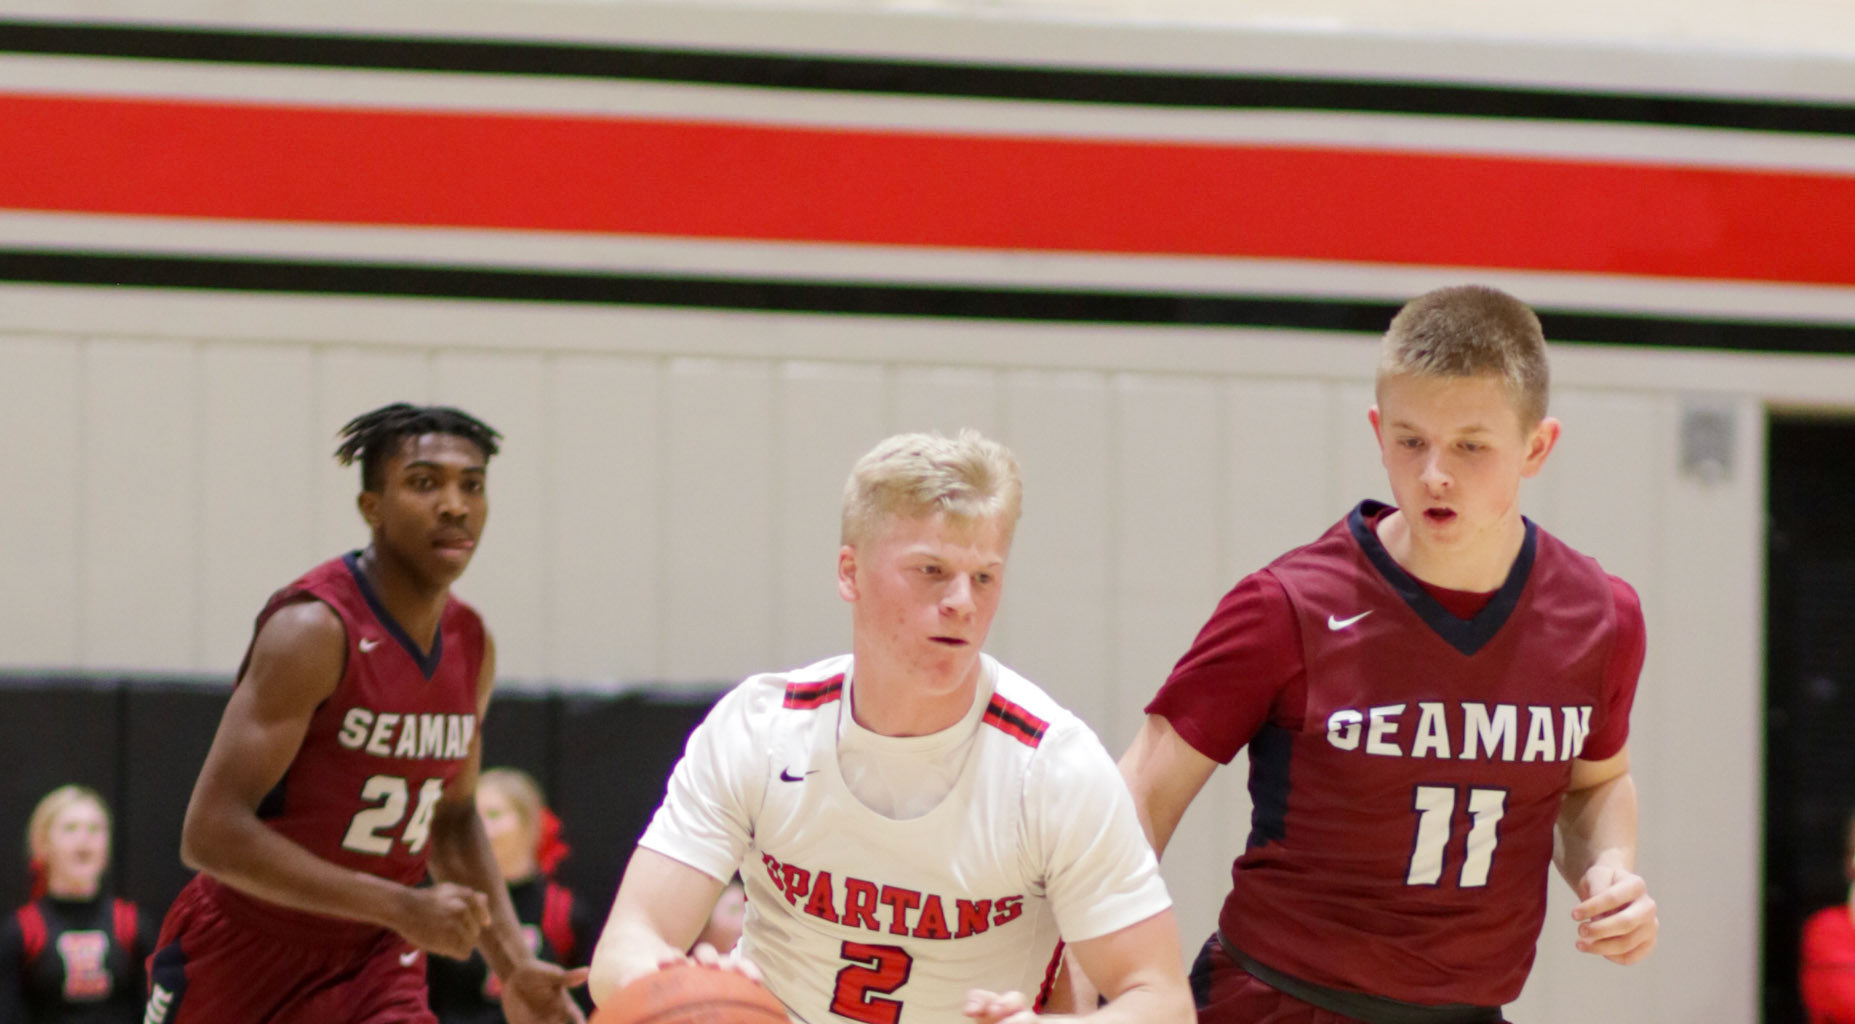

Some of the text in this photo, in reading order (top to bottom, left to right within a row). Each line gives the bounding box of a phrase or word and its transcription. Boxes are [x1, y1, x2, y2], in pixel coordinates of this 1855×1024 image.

[341, 774, 444, 857] 24
[1405, 784, 1508, 888] 11
[760, 851, 1024, 940] SPARTANS
